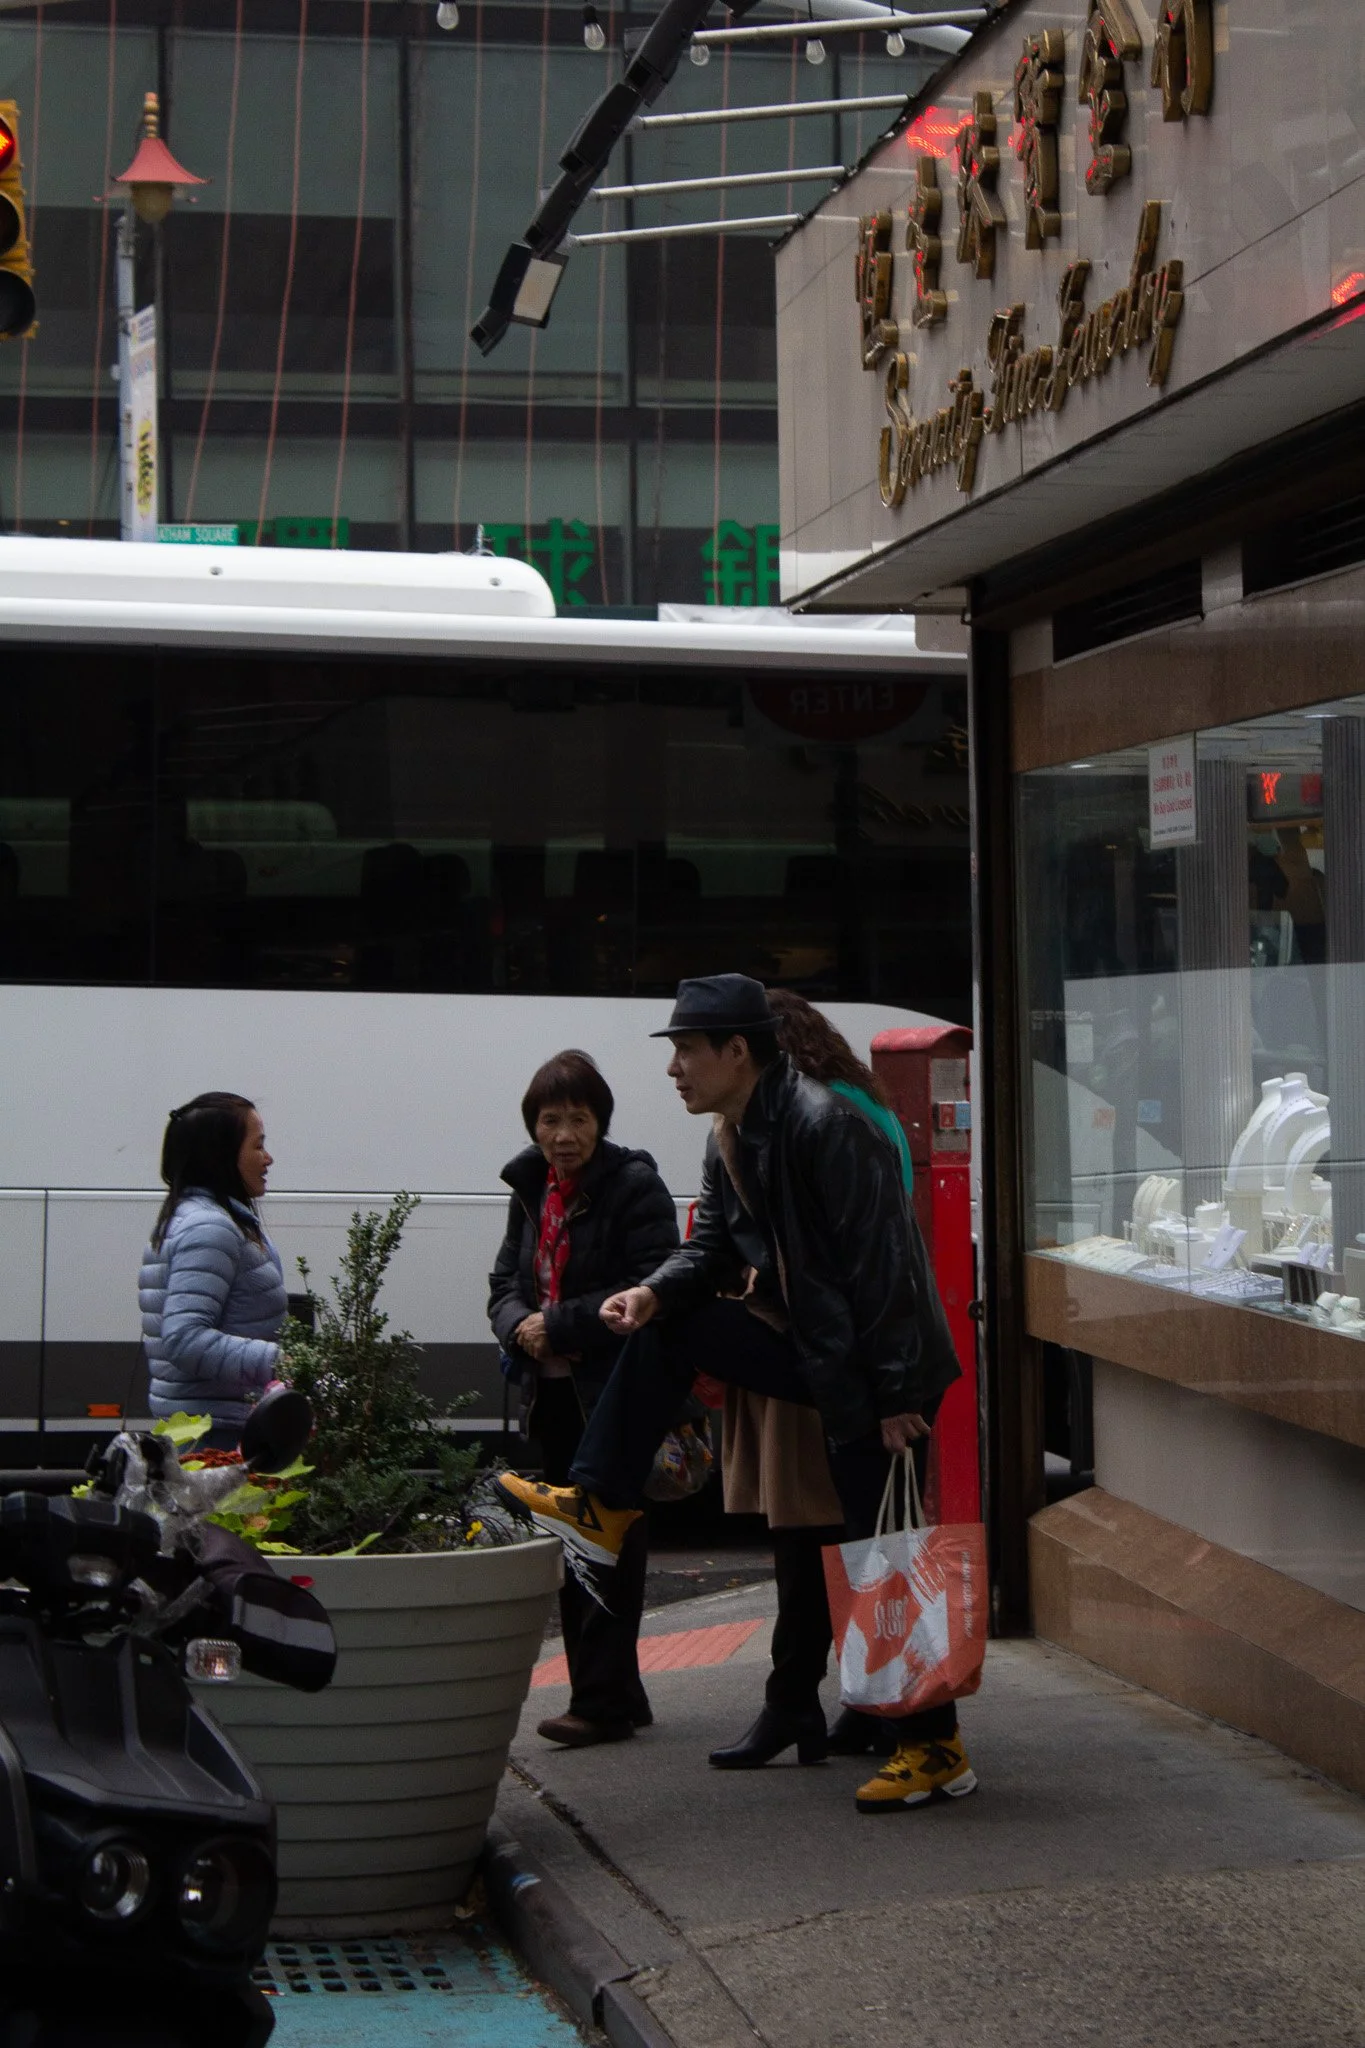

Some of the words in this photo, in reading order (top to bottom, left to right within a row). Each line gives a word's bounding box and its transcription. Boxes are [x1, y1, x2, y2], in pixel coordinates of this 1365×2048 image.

[880, 352, 984, 508] Serenity
[984, 303, 1053, 434] Fine
[1043, 200, 1184, 412] Jewelry
[195, 527, 234, 543] SQUARE
